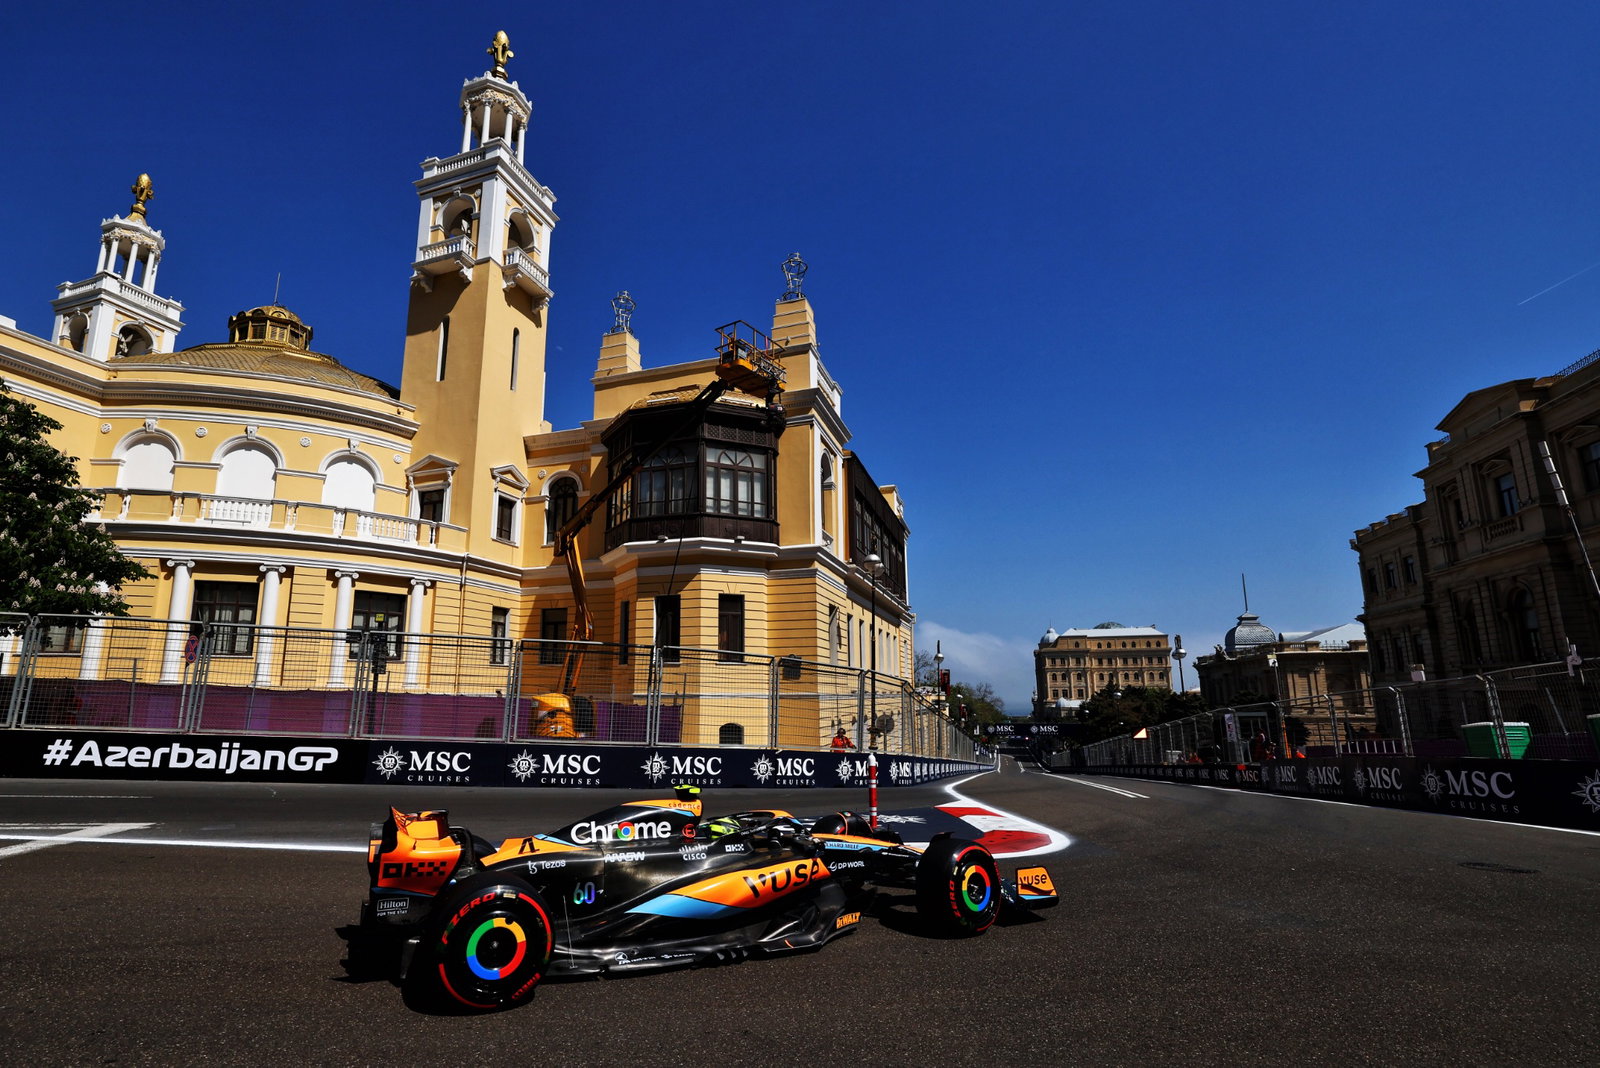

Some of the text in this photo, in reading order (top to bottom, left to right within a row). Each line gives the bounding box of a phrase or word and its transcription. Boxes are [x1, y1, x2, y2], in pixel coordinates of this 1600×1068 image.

[1039, 725, 1059, 733] MSC
[43, 739, 338, 774] #AzerbaijanGP
[408, 750, 472, 773] MSC
[541, 753, 601, 775] MSC
[671, 755, 722, 776] MSC
[776, 758, 815, 777] MSC
[1242, 769, 1259, 783] MSC
[1280, 765, 1297, 783] MSC
[1317, 766, 1341, 786] MSC
[407, 774, 470, 783] CRUISES
[540, 777, 600, 786] CRUISES
[670, 778, 722, 786] CRUISES
[1367, 767, 1403, 790] MSC
[1444, 770, 1516, 799] MSC
[669, 802, 700, 810] cadence
[1450, 800, 1520, 814] CRUISES
[570, 820, 672, 845] Chrome
[682, 852, 707, 861] CISCO
[725, 843, 745, 853] OKX
[382, 861, 447, 879] OKX
[540, 859, 566, 870] Tezos
[573, 881, 596, 905] 60
[380, 900, 407, 909] Hilton
